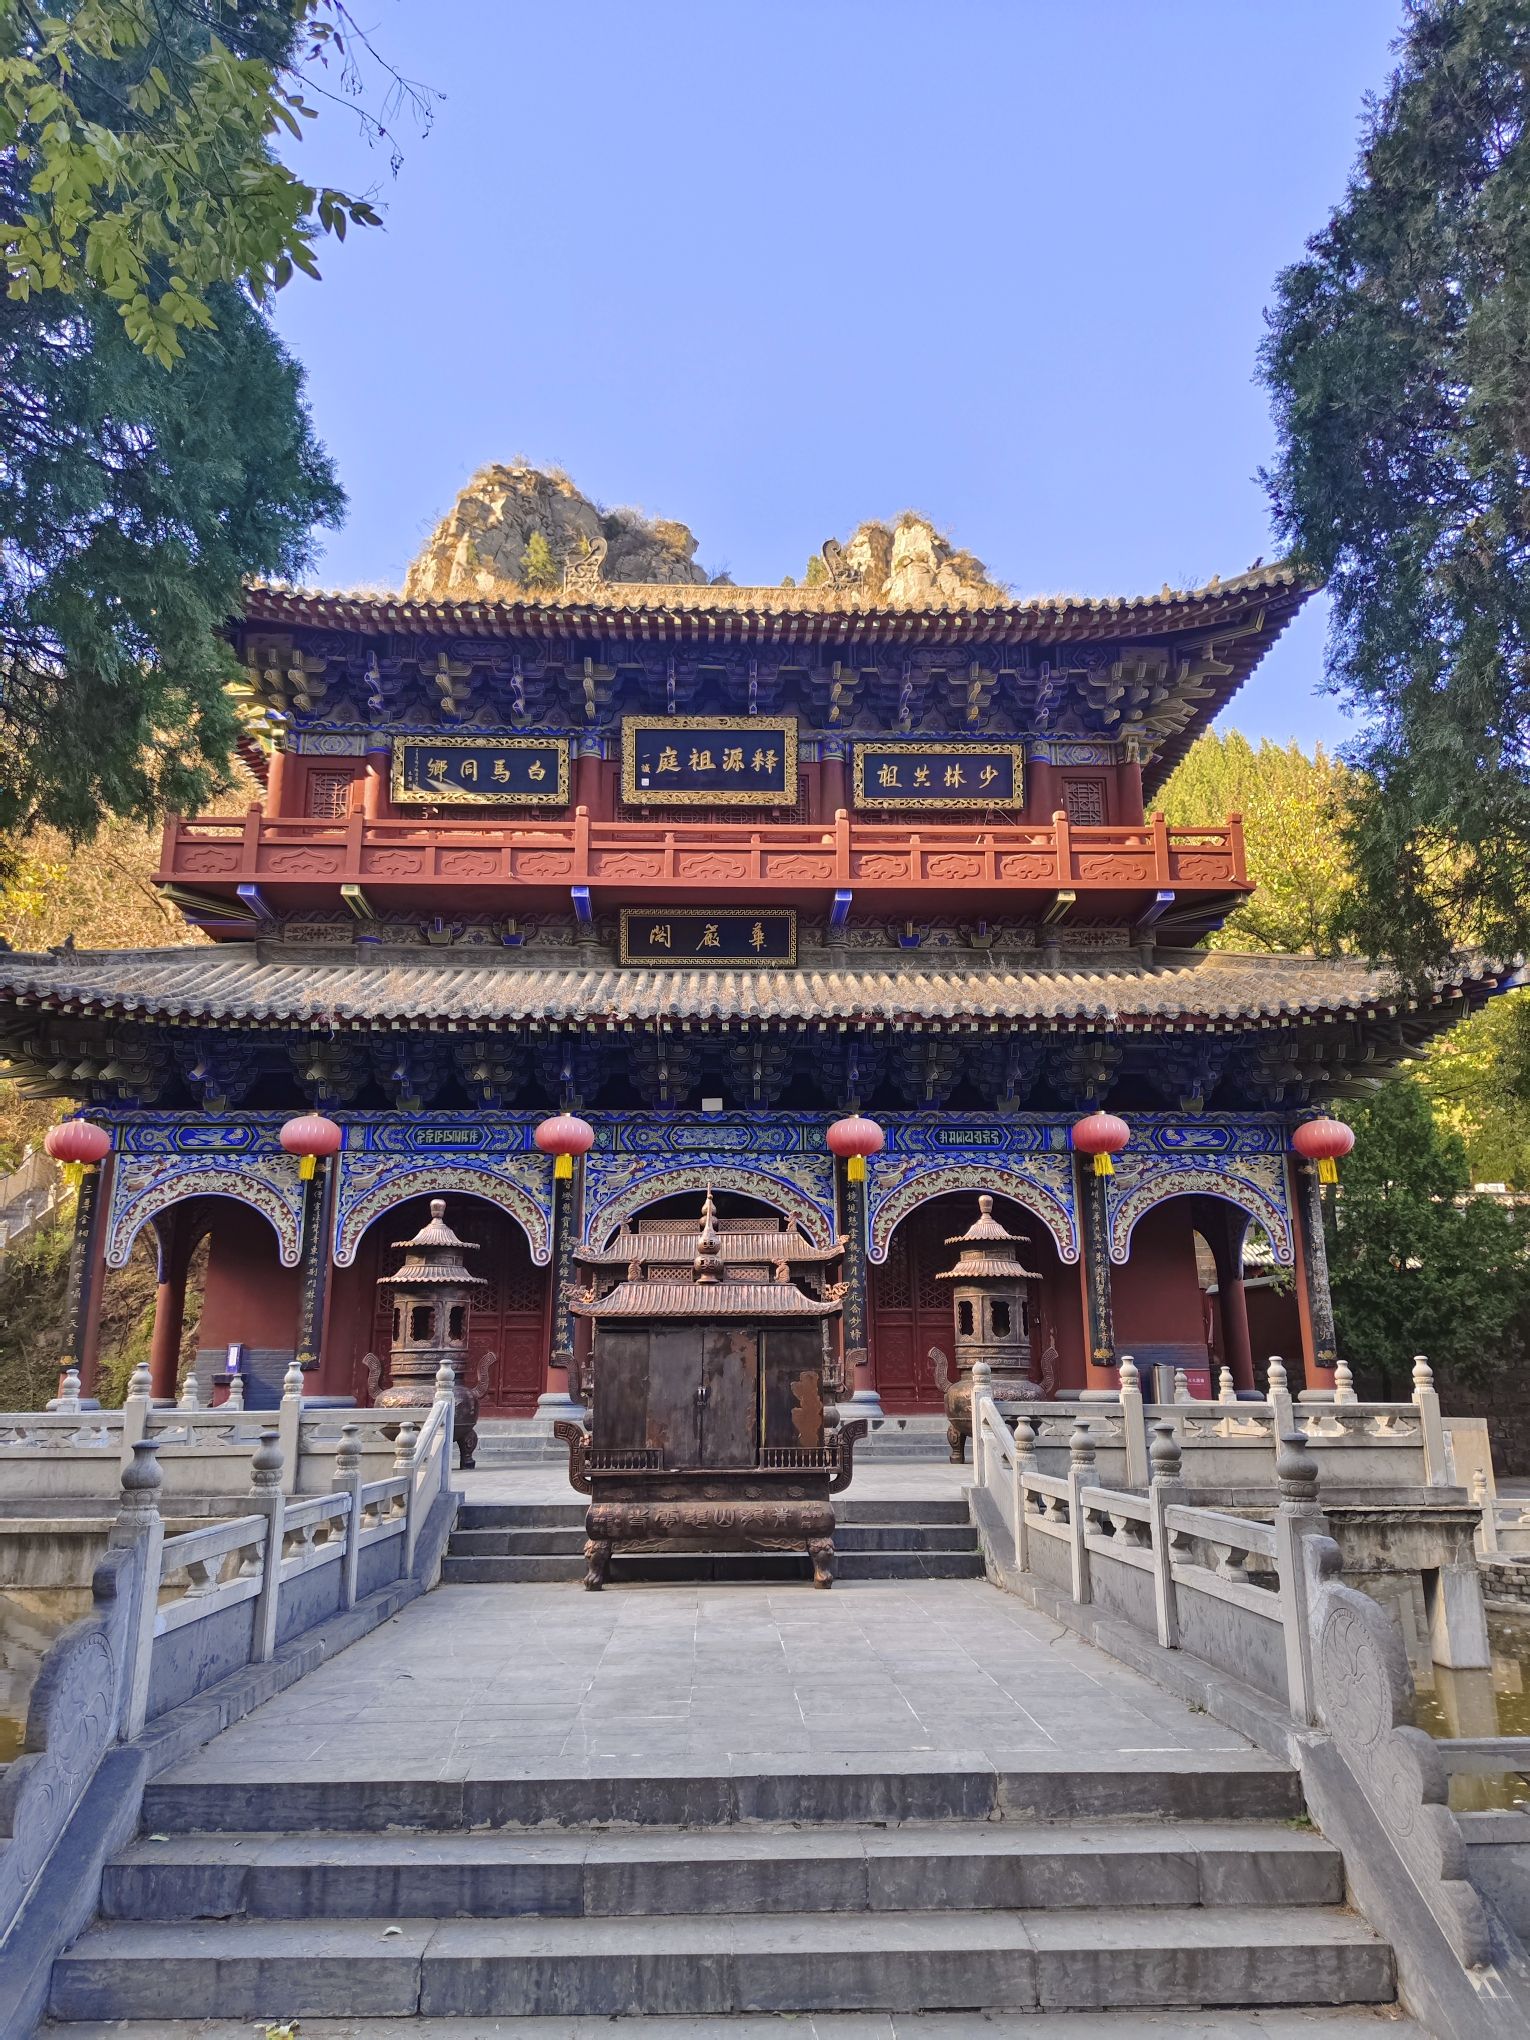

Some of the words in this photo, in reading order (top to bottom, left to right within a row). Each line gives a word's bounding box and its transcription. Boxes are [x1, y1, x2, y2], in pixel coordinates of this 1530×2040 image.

[426, 757, 546, 783] 白馬同鄉
[876, 762, 999, 789] 少林共祖
